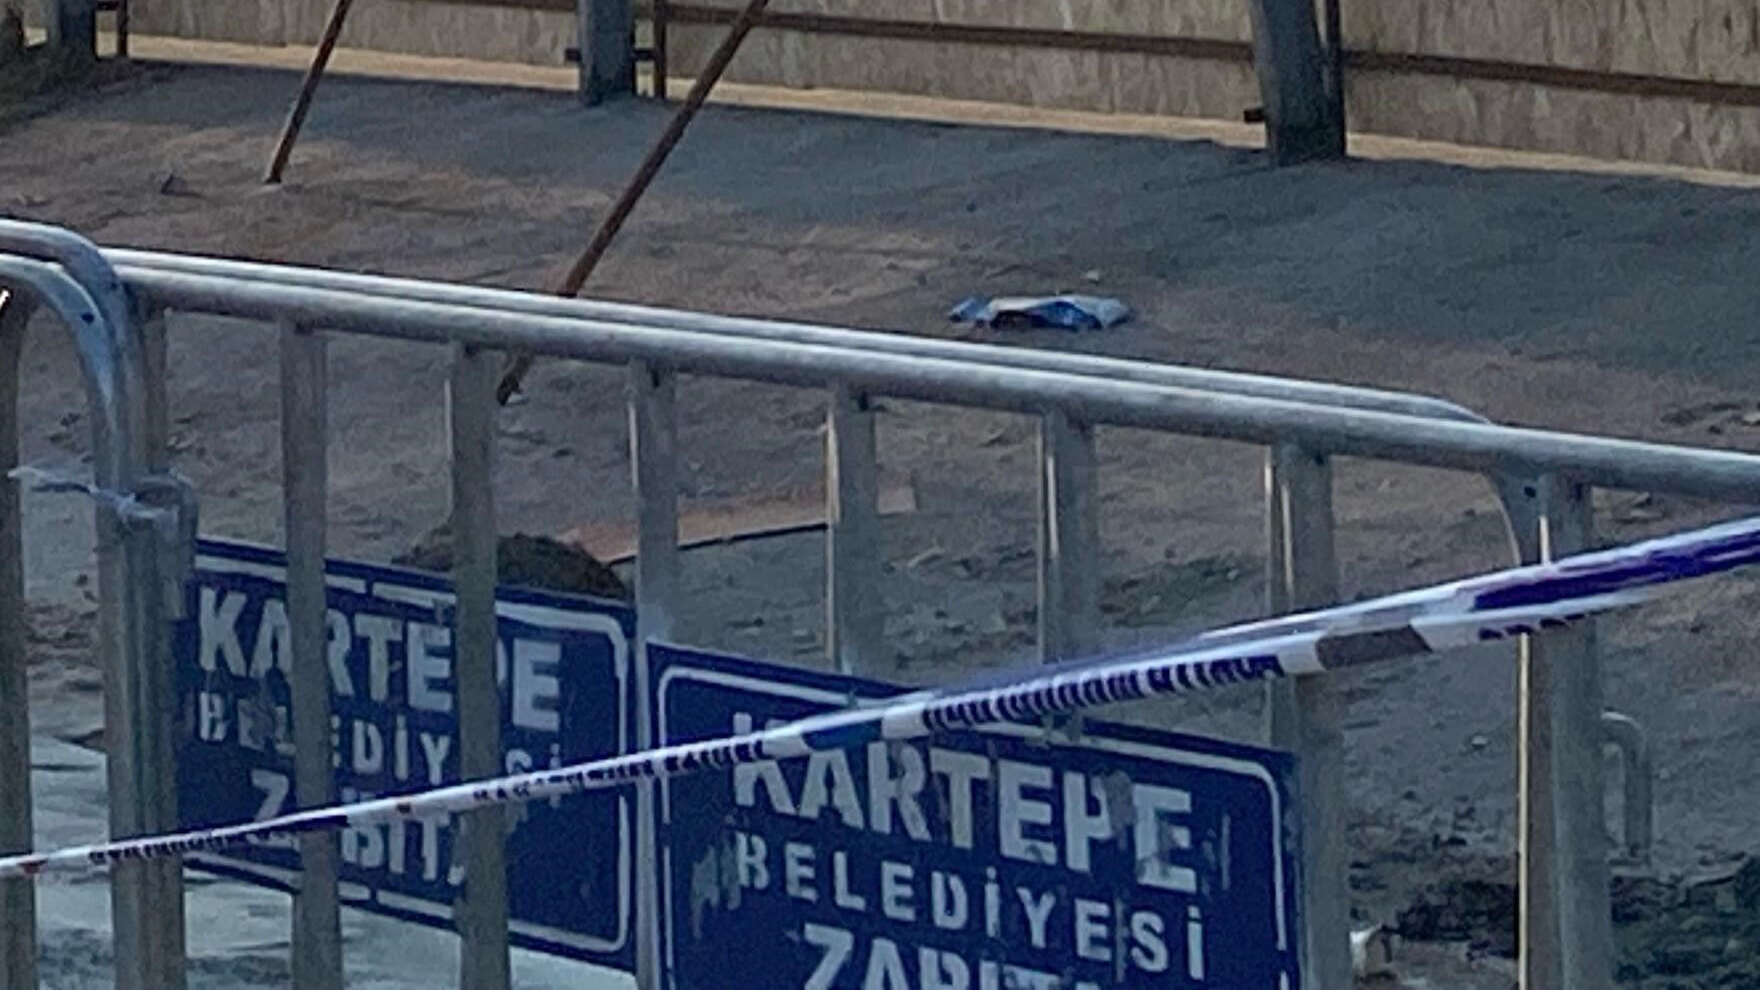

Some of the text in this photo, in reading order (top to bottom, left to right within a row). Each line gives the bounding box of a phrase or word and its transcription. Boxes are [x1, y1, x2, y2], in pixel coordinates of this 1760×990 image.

[198, 586, 562, 732] KARTEE
[249, 767, 468, 886] ZBIT
[733, 712, 1198, 894] KARTEPE
[736, 831, 1207, 981] BELEDİYESİ
